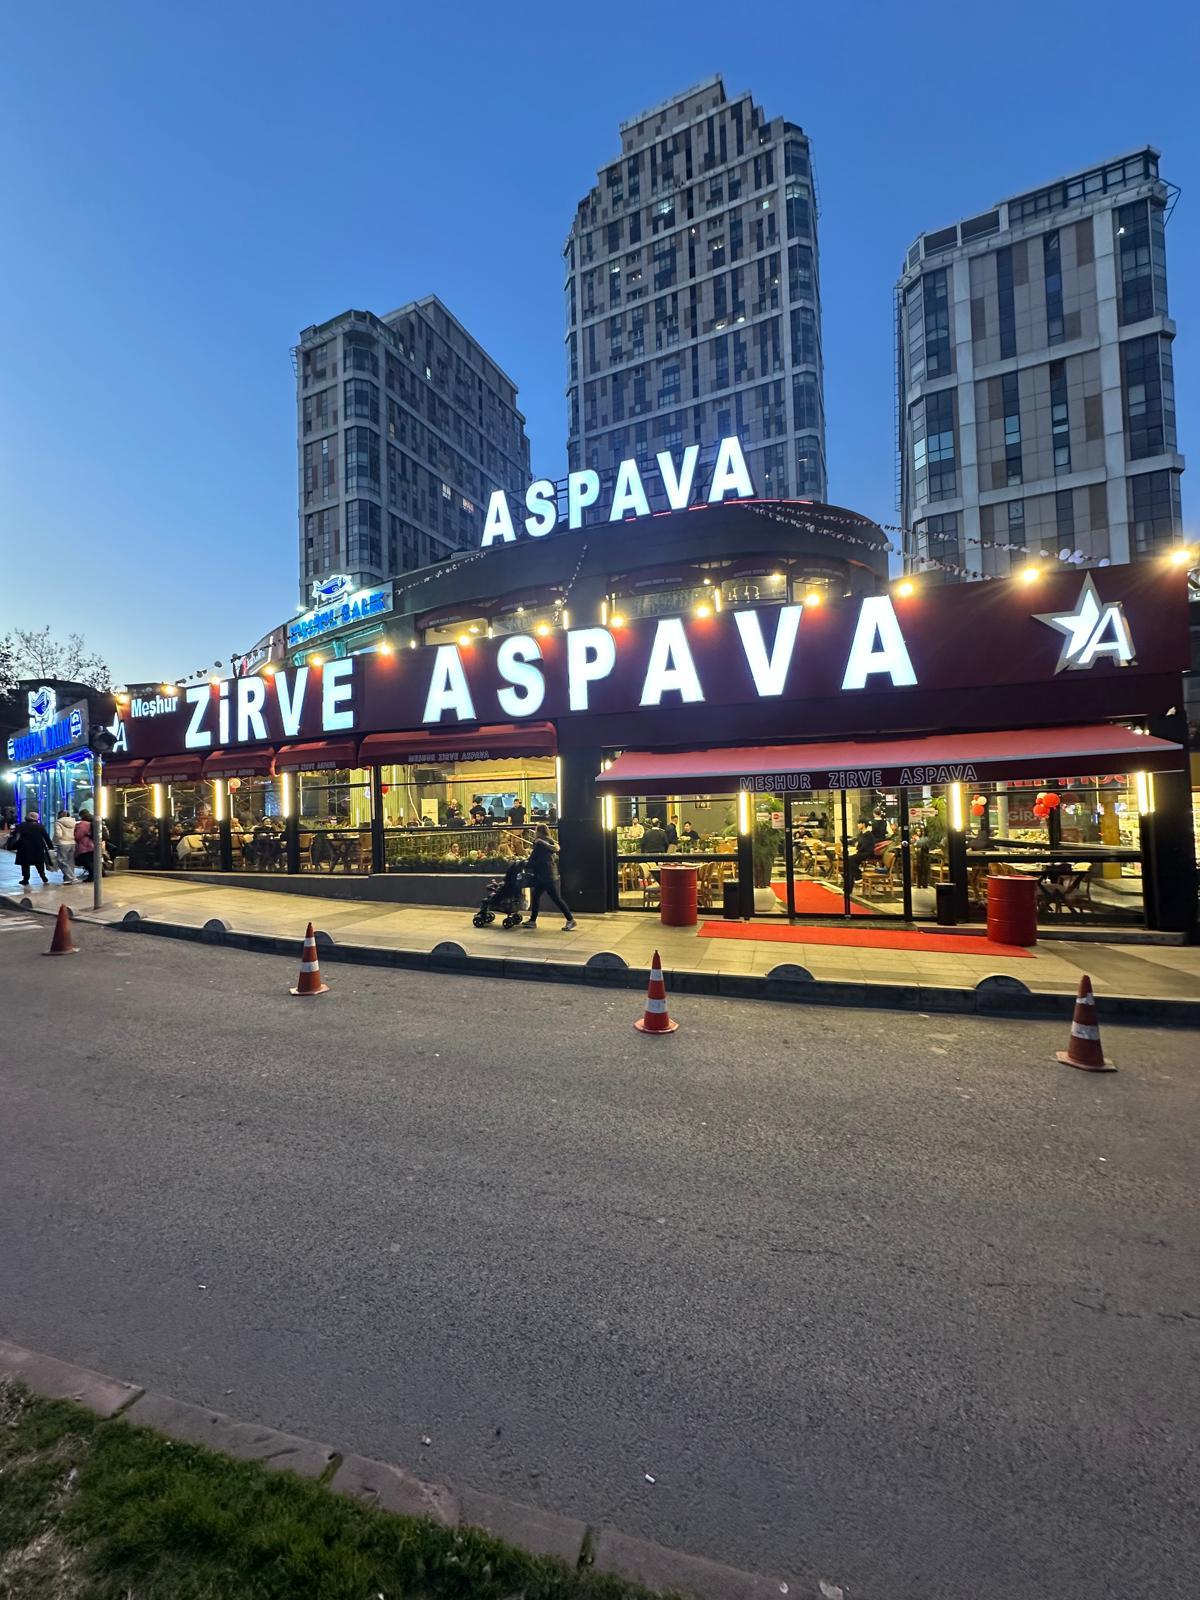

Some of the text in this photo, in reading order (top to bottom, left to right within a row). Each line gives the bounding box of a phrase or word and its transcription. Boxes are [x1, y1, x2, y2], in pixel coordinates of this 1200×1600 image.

[480, 436, 754, 547] ASPAVA
[131, 695, 178, 718] Meşhur
[422, 594, 919, 724] ASPAVA
[739, 774, 811, 793] MEŞHUR
[899, 764, 977, 785] ASPAVA
